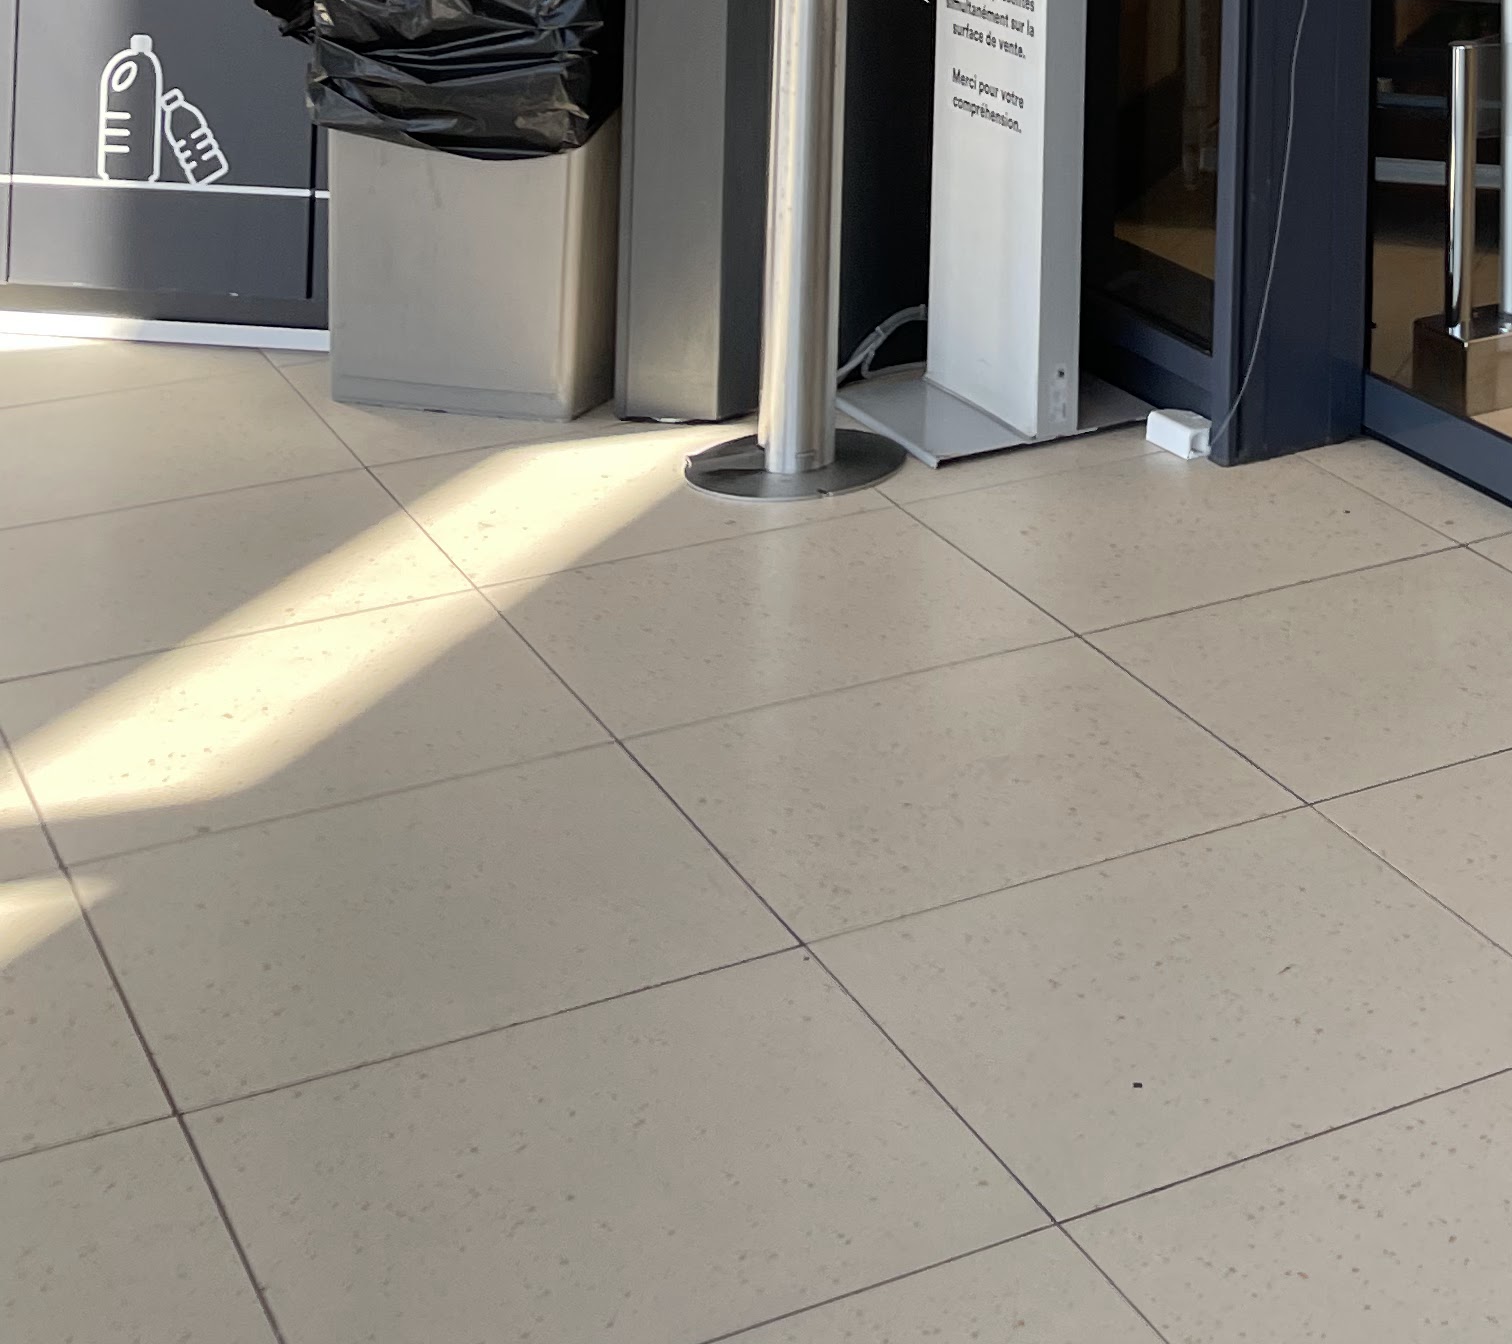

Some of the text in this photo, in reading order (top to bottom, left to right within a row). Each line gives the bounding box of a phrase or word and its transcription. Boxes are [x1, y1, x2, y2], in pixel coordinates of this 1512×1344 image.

[952, 23, 1026, 59] surface de vente.
[1011, 17, 1025, 33] sur
[1026, 19, 1035, 37] la
[952, 67, 1024, 109] Merci pour votre
[952, 96, 1022, 133] compréhension.
